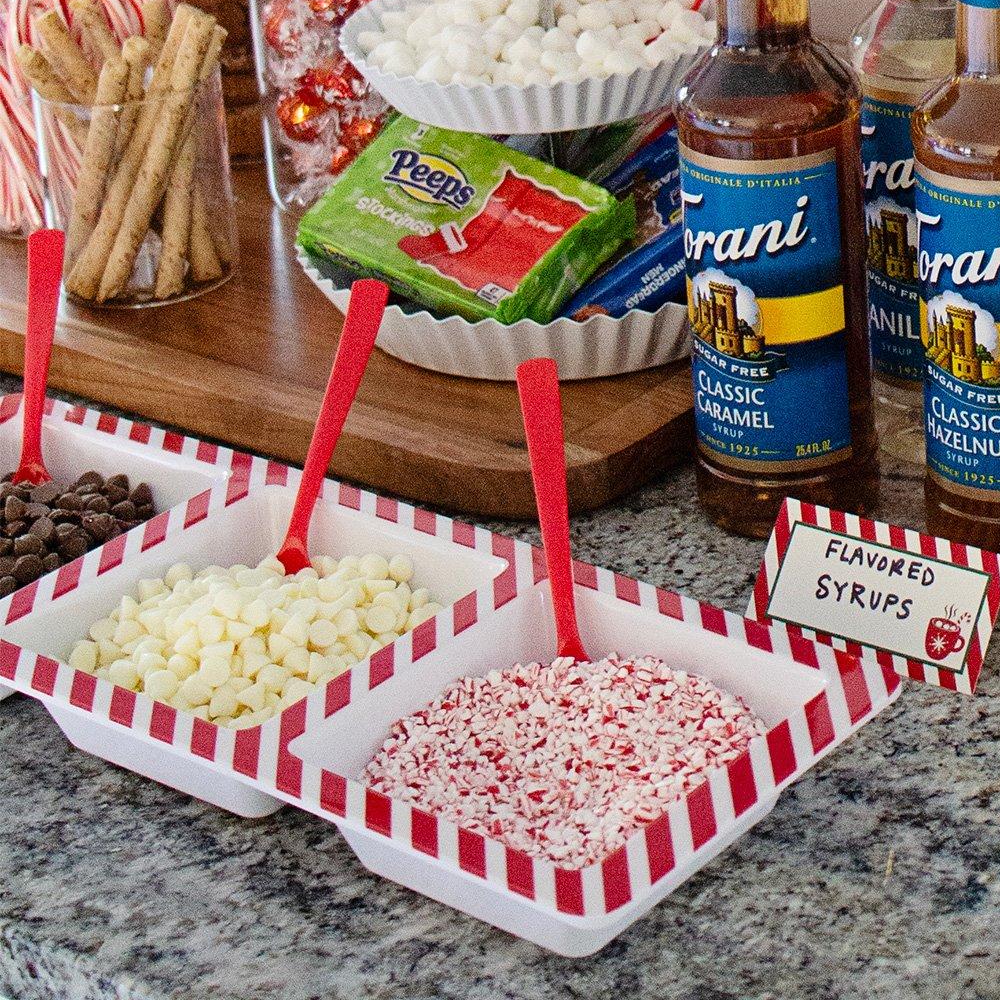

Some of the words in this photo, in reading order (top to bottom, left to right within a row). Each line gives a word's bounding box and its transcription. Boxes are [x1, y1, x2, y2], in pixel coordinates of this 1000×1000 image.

[387, 149, 476, 207] Peeps
[928, 189, 983, 209] ORIGINALE
[868, 269, 898, 294] UGAR
[693, 339, 727, 370] SUGAR
[731, 364, 769, 378] FREE
[698, 369, 766, 406] CLASSIC
[927, 364, 963, 396] SUGAR
[697, 390, 775, 429] CARAMEL
[712, 422, 744, 439] SYRUP
[730, 442, 759, 456] 1925
[946, 450, 980, 468] SYRUP
[964, 470, 995, 485] 1925
[825, 538, 936, 587] FLAVORED
[815, 573, 914, 620] SYRUPS
